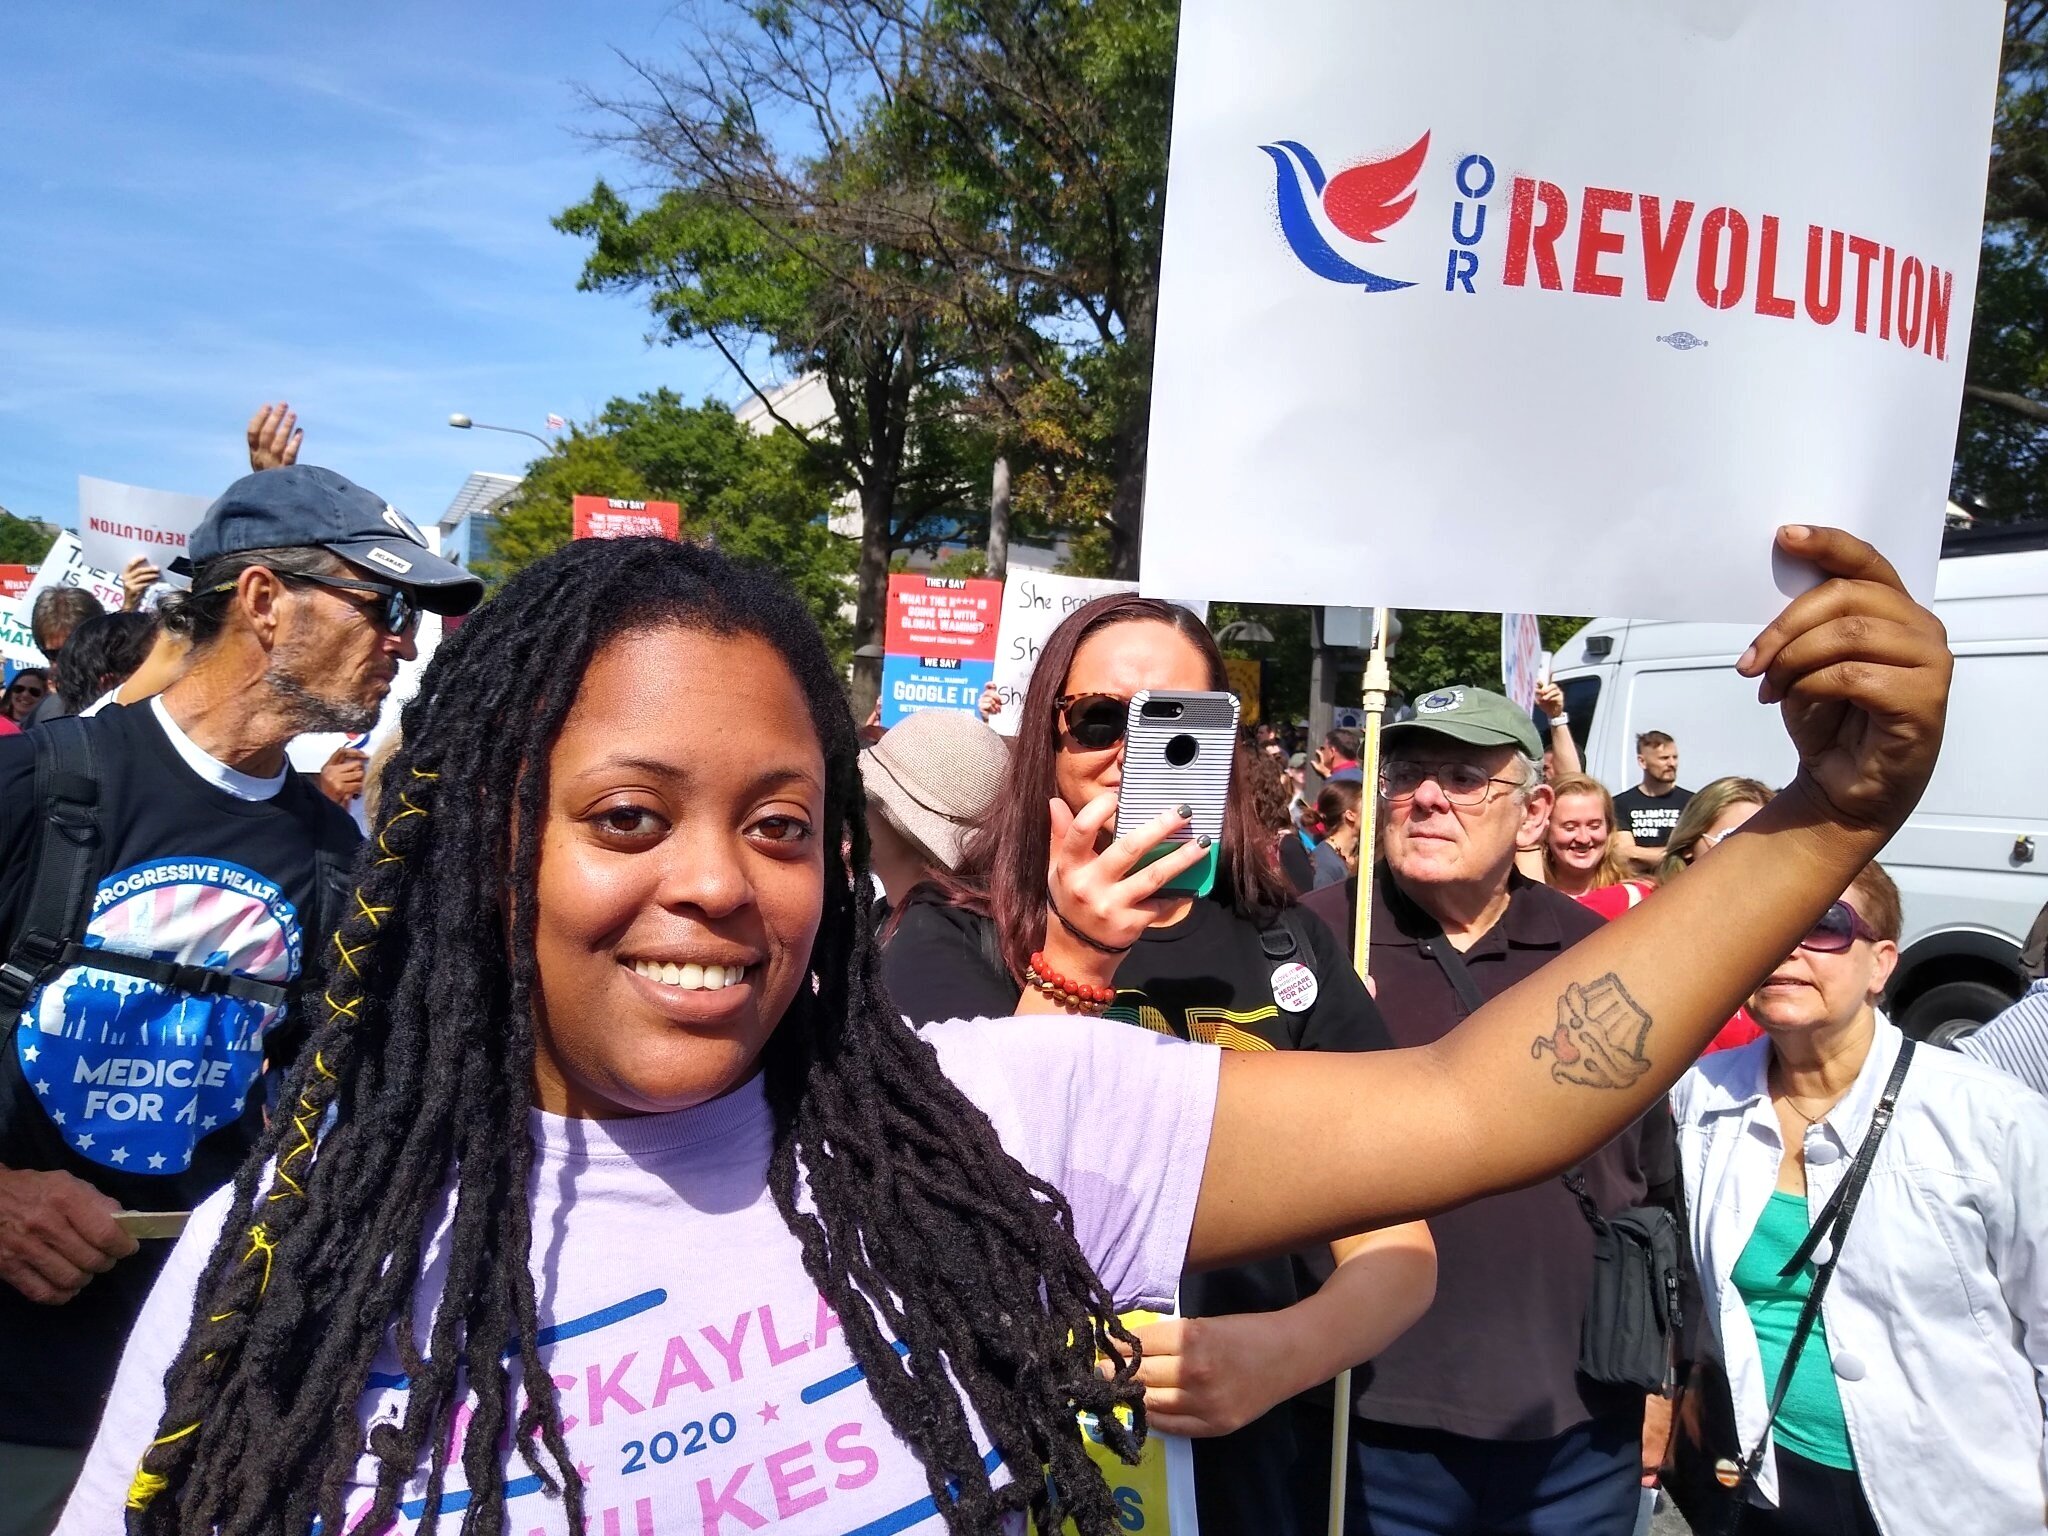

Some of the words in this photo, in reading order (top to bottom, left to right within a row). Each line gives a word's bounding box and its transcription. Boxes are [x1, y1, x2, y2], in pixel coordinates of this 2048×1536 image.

[1445, 153, 1495, 294] OUR
[1502, 175, 1953, 362] REVOLUTION
[89, 517, 186, 547] REVOLUTION
[374, 552, 406, 569] DELAWARE
[926, 577, 947, 588] THEY
[948, 578, 966, 590] SAY
[929, 594, 947, 608] THE
[977, 598, 988, 610] IS
[1019, 581, 1051, 609] She
[1062, 594, 1093, 612] pro
[901, 616, 937, 631] GLOBAL
[908, 606, 936, 618] GOING
[937, 608, 951, 620] ON
[953, 609, 977, 621] WITH
[1011, 637, 1040, 661] Sh
[924, 657, 938, 668] WE
[939, 658, 958, 669] SAY
[893, 681, 958, 705] GOOGLE
[962, 688, 979, 706] IT
[1630, 808, 1680, 819] CLIMATE
[1631, 818, 1678, 828] JUSTICE
[1632, 828, 1659, 837] NOW
[93, 864, 219, 914] PROGRESSIVE
[1278, 975, 1310, 996] MEDICARE
[1281, 990, 1297, 1002] FOR
[1297, 981, 1313, 994] ALL!
[84, 1090, 164, 1122] FOR
[621, 1411, 737, 1475] 2020
